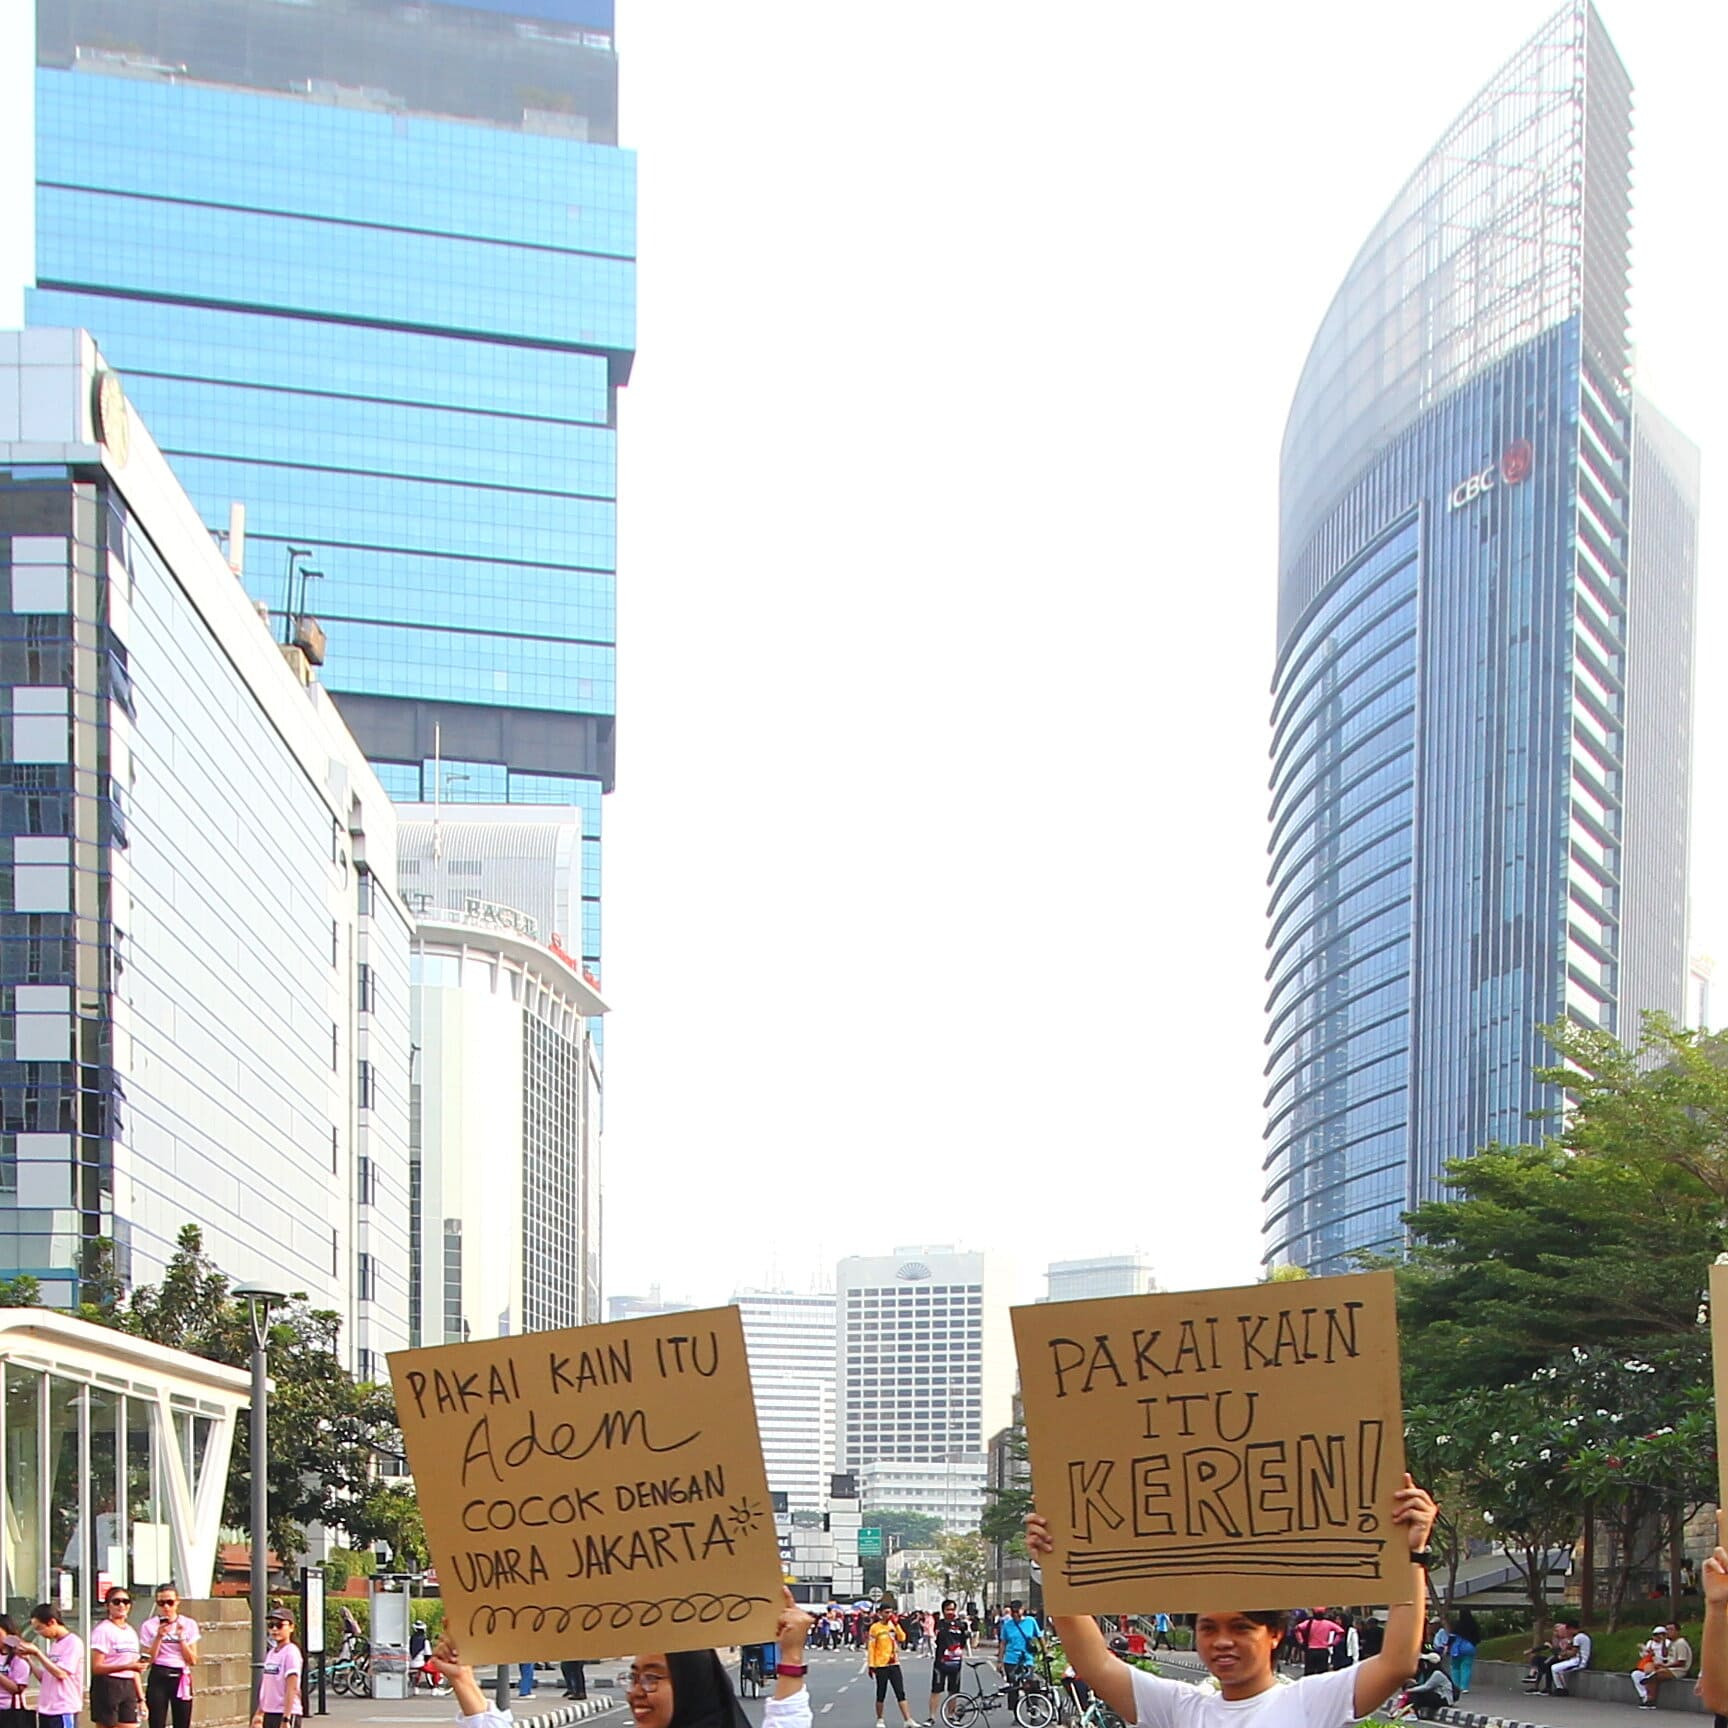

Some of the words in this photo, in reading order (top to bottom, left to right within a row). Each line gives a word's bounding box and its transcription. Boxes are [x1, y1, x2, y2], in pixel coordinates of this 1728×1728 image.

[1446, 463, 1496, 513] ICBC
[405, 1357, 522, 1419] PAKAI
[549, 1338, 633, 1394] KAIN
[655, 1331, 719, 1378] ITU
[1048, 1316, 1223, 1398] PAKAI
[1236, 1301, 1364, 1371] KAIN
[461, 1408, 703, 1487] Adem
[1136, 1390, 1260, 1442] ITU
[461, 1487, 604, 1533] COCOK
[614, 1464, 727, 1513] DENGAN
[1068, 1419, 1384, 1544] KEREN!
[451, 1544, 549, 1594] UDARA
[566, 1513, 736, 1580] JAKARTA
